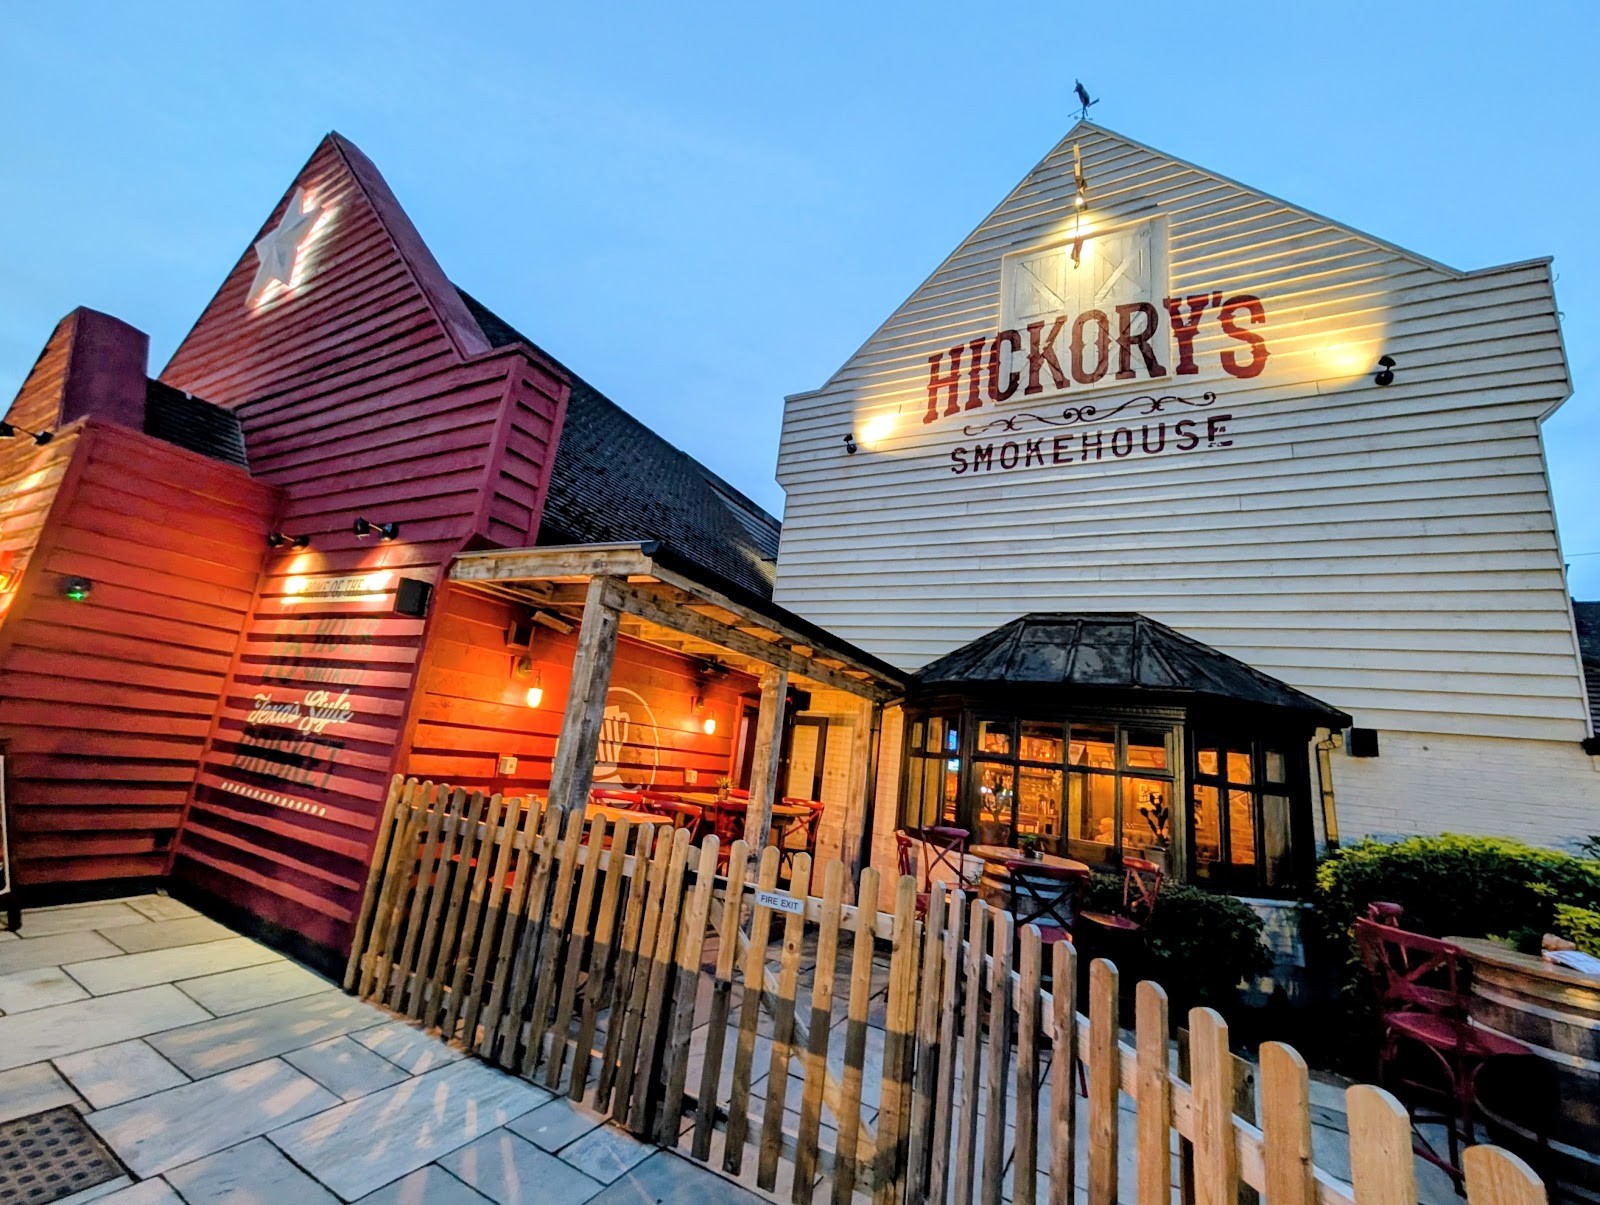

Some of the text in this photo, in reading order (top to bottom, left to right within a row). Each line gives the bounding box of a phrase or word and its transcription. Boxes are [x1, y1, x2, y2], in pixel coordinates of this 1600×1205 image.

[923, 291, 1271, 424] HICKORY'S
[949, 413, 1233, 475] SMOKEHOUSE
[330, 579, 345, 598] OF
[247, 688, 354, 735] Texas Style
[761, 895, 798, 909] FIRE EXIT
